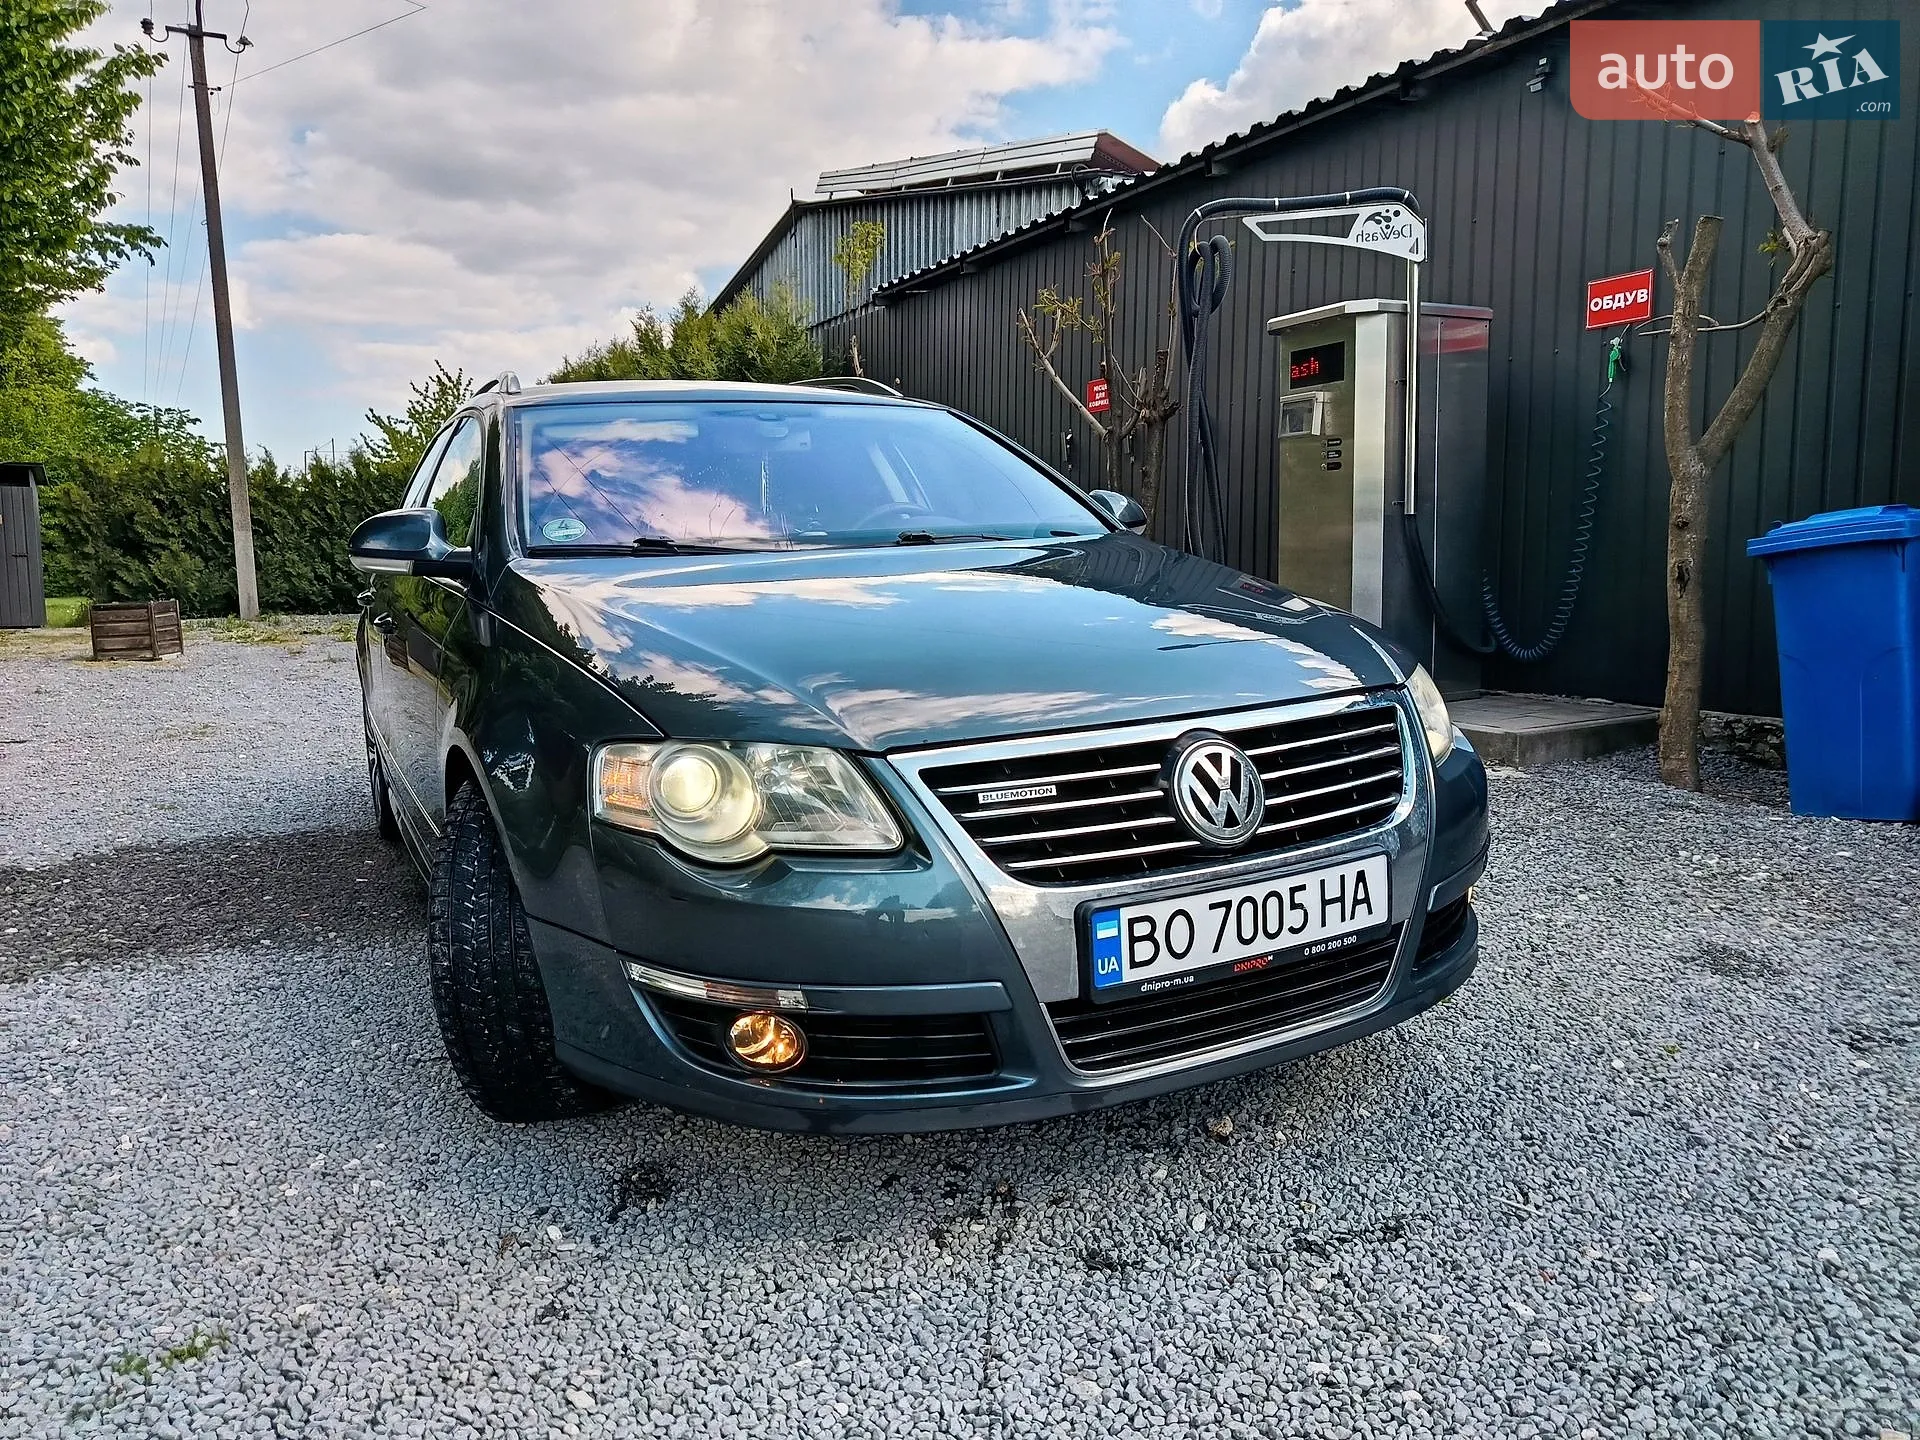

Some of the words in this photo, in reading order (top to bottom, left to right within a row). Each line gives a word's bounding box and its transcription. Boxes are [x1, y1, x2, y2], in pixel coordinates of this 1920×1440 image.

[1590, 288, 1648, 312] ОБДУВ
[981, 786, 1053, 802] BLUEMOTION
[1127, 908, 1195, 970] BO
[1207, 883, 1309, 954] 7005
[1319, 869, 1373, 928] HA
[1311, 943, 1326, 954] 800
[1327, 940, 1342, 950] 200
[1343, 935, 1357, 946] 500
[1097, 956, 1120, 975] UA
[1140, 975, 1195, 992] dnipro-m.ua
